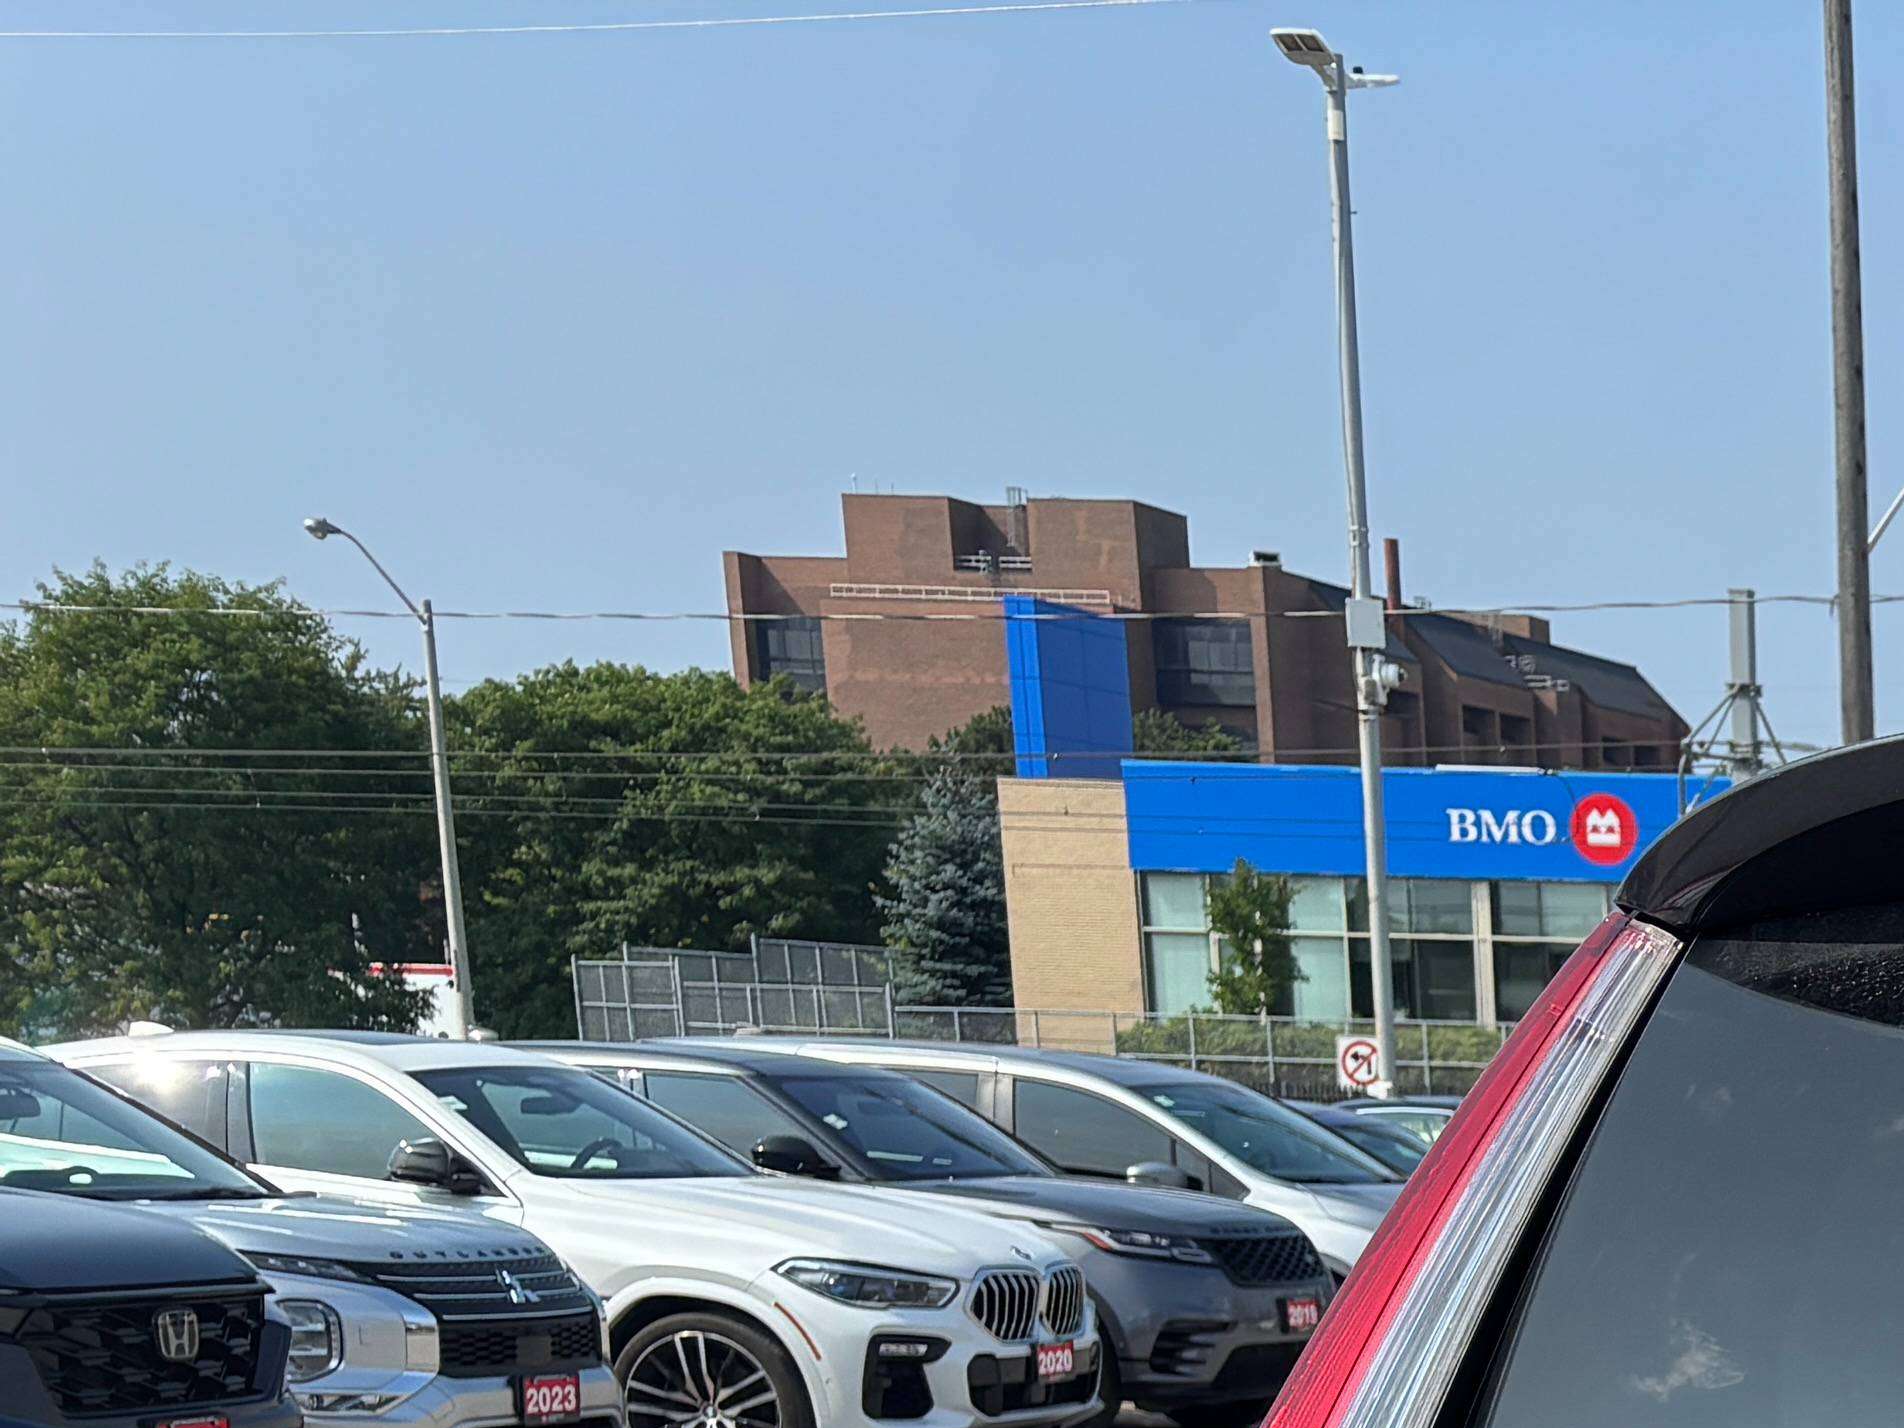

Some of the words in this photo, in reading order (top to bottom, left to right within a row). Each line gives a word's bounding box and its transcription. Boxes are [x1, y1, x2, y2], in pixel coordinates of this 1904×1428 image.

[1446, 808, 1556, 846] BMO
[1038, 1349, 1073, 1376] 2020
[526, 1384, 577, 1414] 2023
